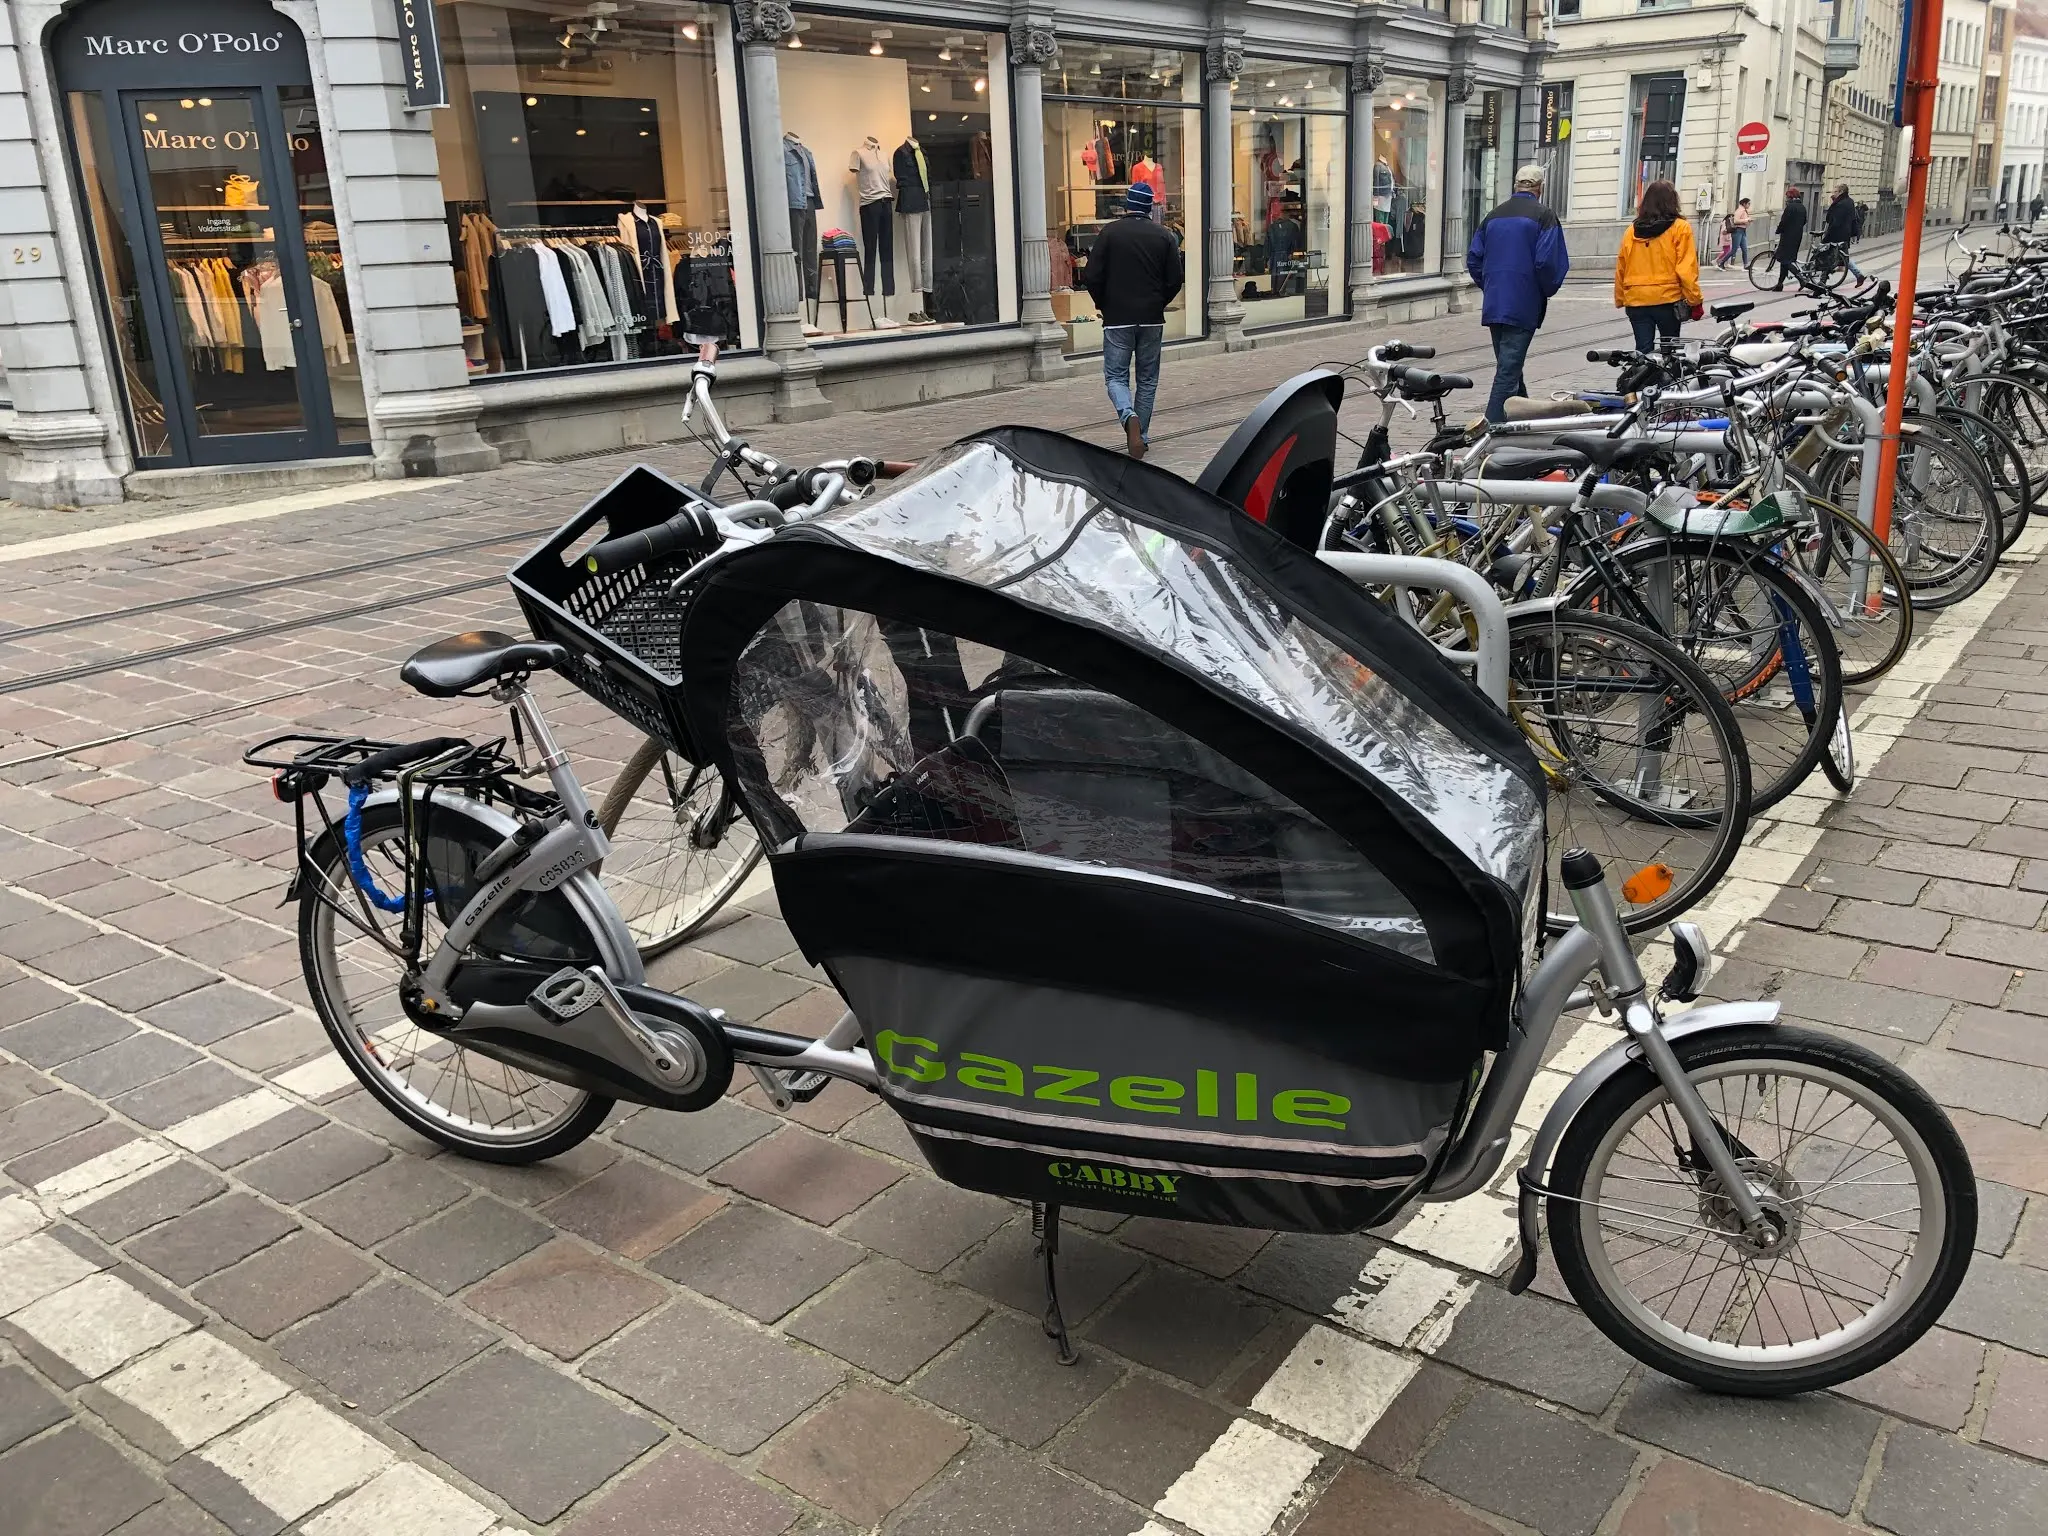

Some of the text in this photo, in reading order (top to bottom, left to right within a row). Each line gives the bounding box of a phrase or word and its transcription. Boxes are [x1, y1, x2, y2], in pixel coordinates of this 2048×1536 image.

[84, 35, 169, 56] Marc
[408, 34, 425, 90] Marc
[142, 129, 216, 149] Marc
[1545, 120, 1553, 143] Marc
[207, 219, 231, 227] Ingang
[13, 247, 42, 264] 29
[464, 875, 512, 927] Gazelle
[875, 1029, 1352, 1130] Gazelle
[1047, 1162, 1183, 1194] CABBY
